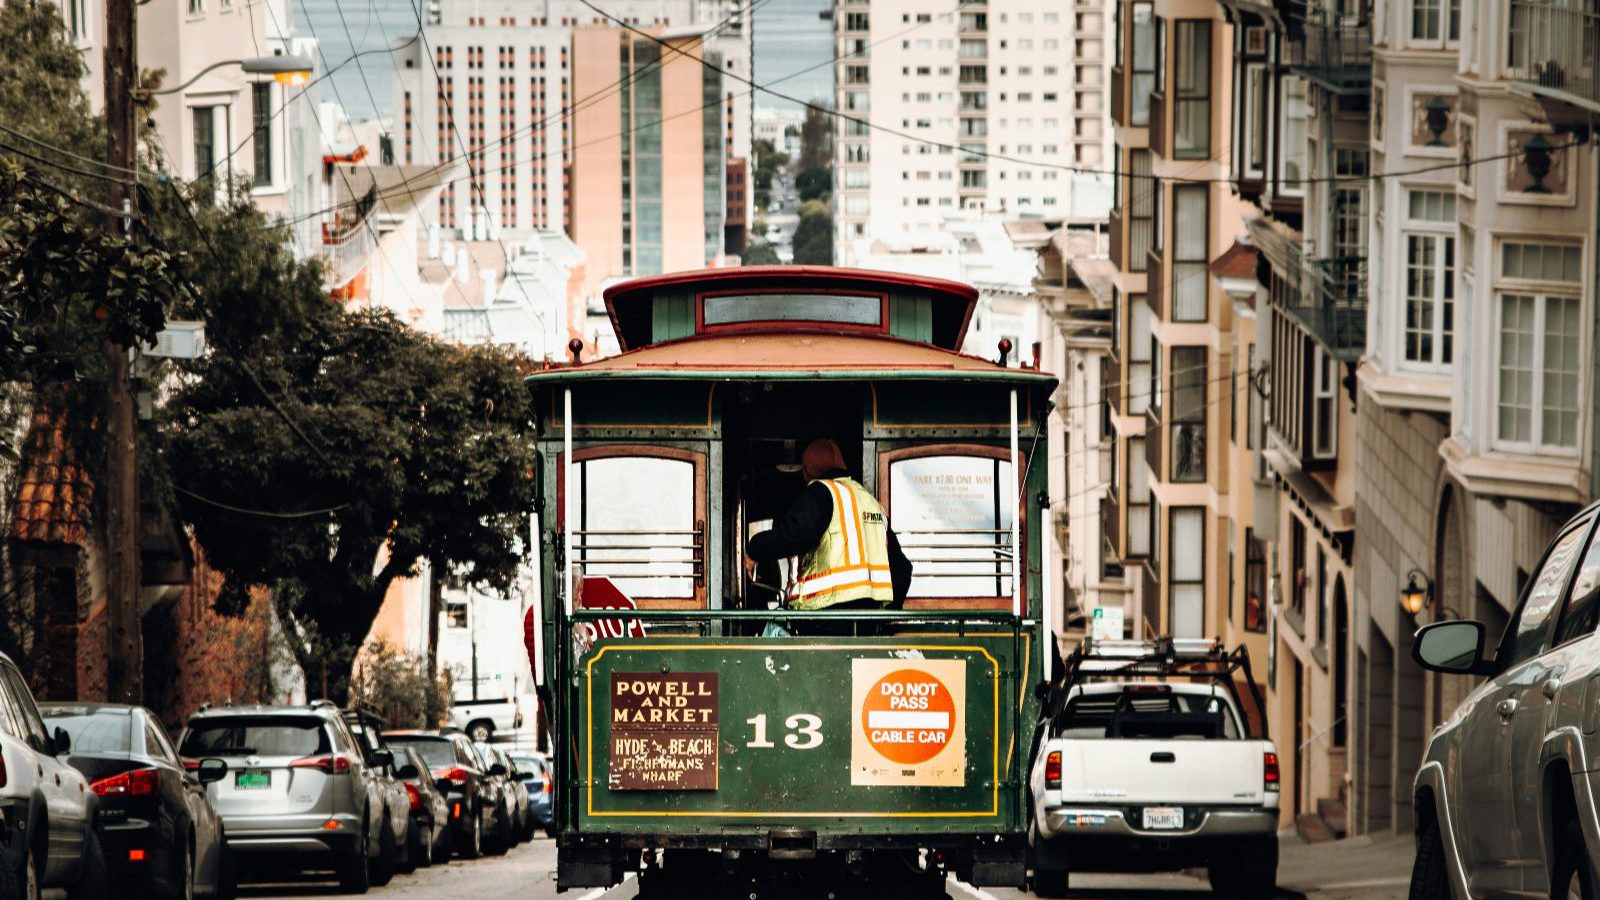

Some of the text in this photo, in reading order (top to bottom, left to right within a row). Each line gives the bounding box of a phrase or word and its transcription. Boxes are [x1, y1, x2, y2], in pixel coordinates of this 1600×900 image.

[975, 475, 992, 486] WAY
[616, 681, 712, 696] POWELL
[881, 682, 938, 696] DO NOT
[641, 696, 688, 708] AND
[890, 697, 929, 709] PASS
[614, 708, 713, 723] MARKET
[746, 713, 824, 749] 13
[871, 730, 946, 743] CABLE CAR
[615, 738, 648, 756] HYDE
[669, 739, 713, 756] BEACH
[642, 770, 684, 782] WHARF
